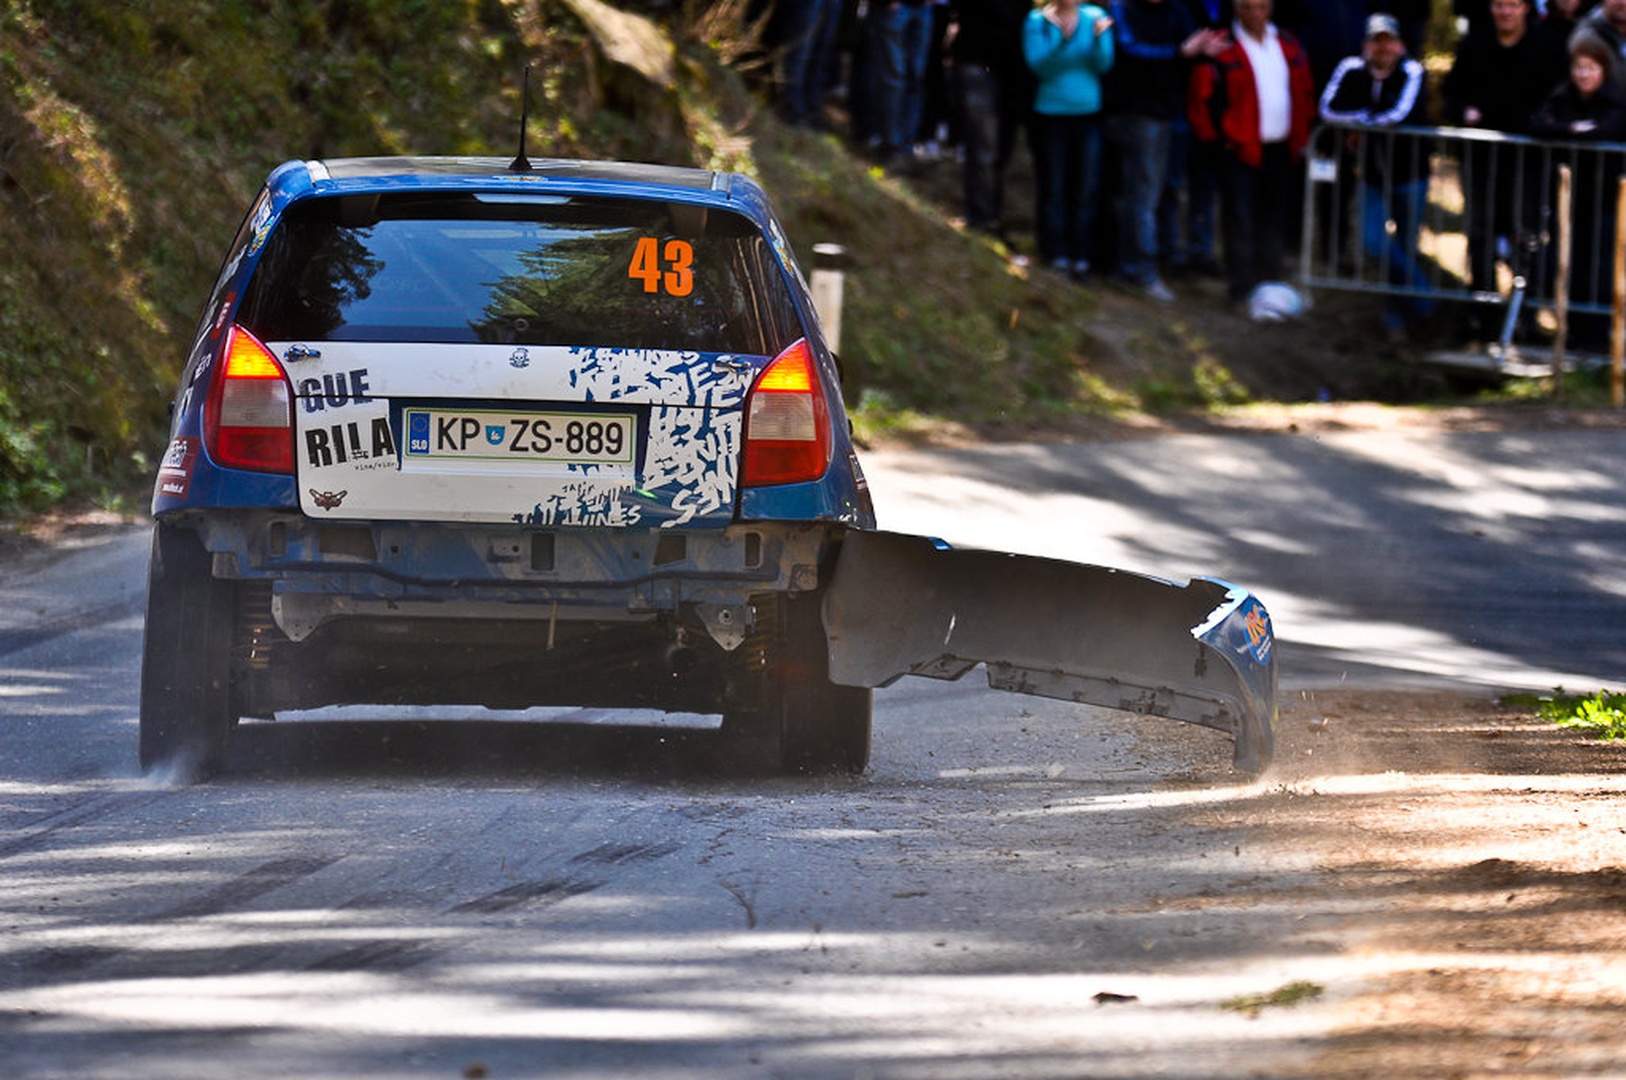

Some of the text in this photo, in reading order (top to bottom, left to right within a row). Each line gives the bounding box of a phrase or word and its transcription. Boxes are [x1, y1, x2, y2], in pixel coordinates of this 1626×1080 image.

[629, 238, 693, 297] 43
[300, 368, 373, 413] GUE
[305, 418, 396, 468] RILA
[411, 439, 427, 450] SLO
[437, 417, 624, 456] KP ZS-889
